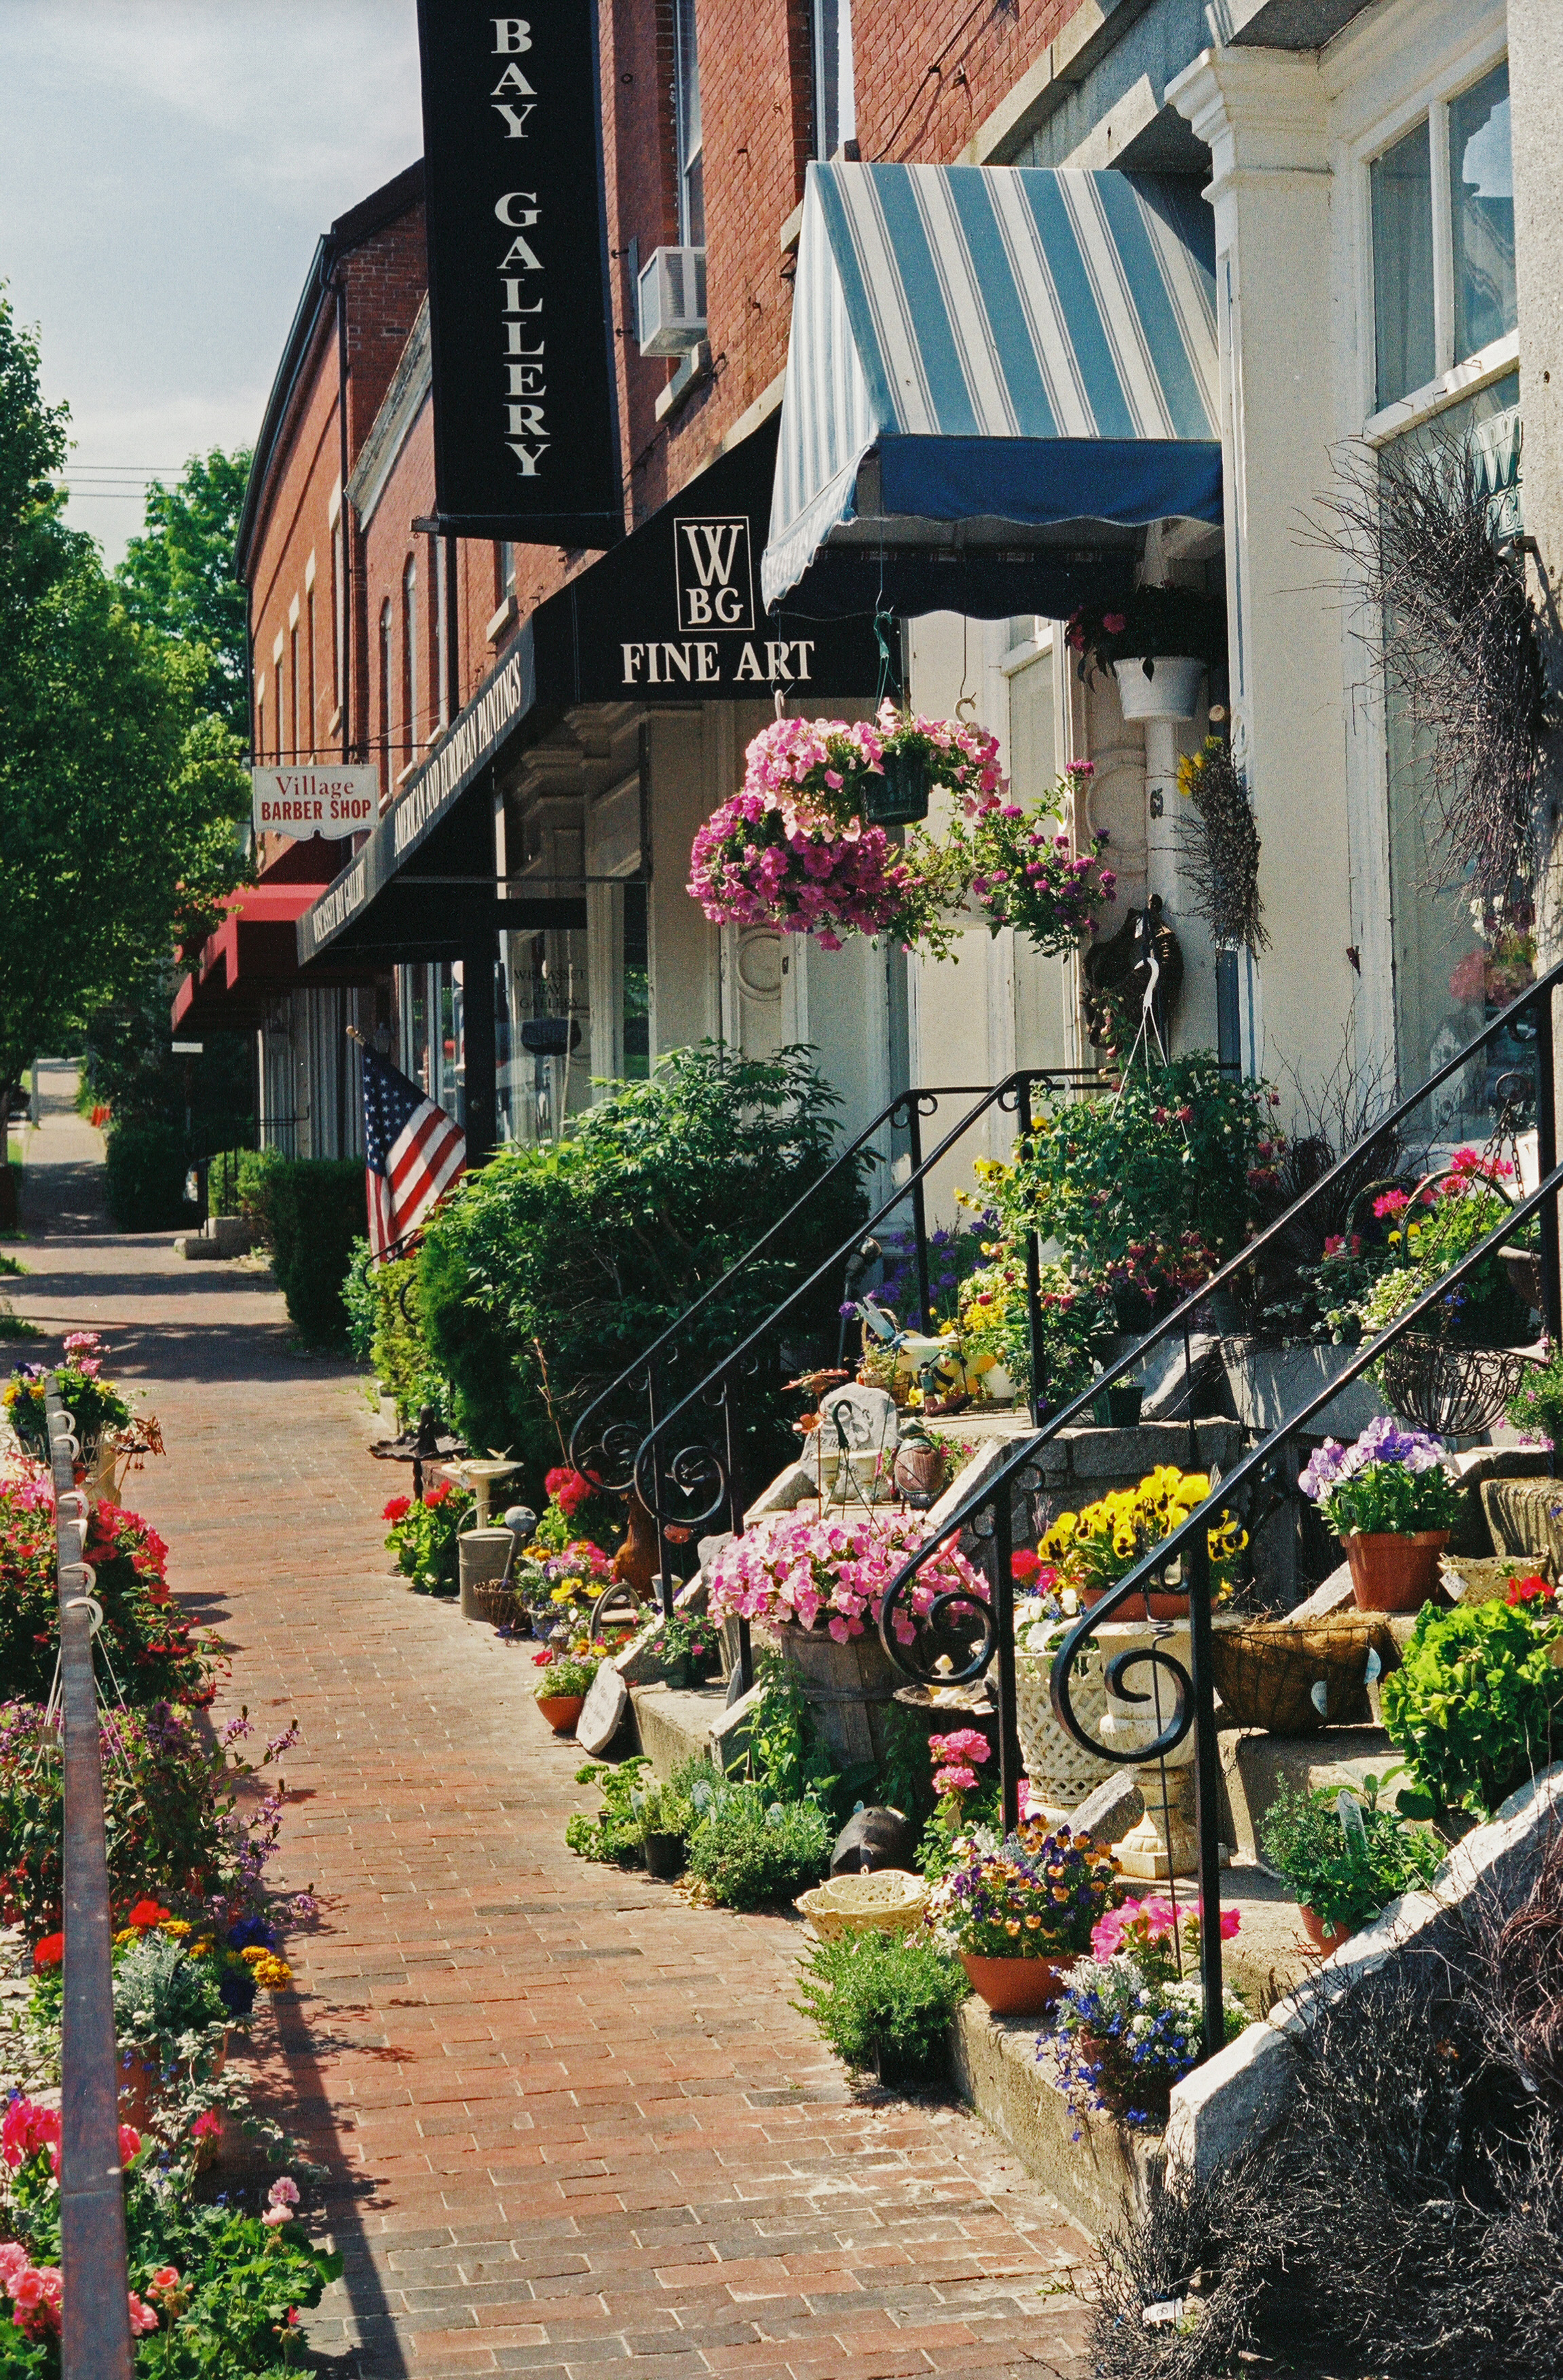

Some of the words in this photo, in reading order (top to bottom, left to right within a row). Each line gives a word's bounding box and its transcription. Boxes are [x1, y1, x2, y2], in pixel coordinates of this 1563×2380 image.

[490, 19, 537, 138] BAY
[495, 192, 550, 476] GALLERY
[681, 525, 744, 586] W
[685, 587, 744, 624] BG
[620, 642, 720, 683] FINE
[732, 641, 814, 681] ART
[394, 776, 425, 857] AMERICAN
[426, 759, 440, 818] AND
[440, 710, 476, 800] EUROPEAN
[477, 651, 521, 754] PAINTINGS
[276, 775, 354, 799] Village
[261, 801, 322, 821] BARBER
[330, 799, 372, 819] SHOP
[514, 969, 586, 981] WISASSET
